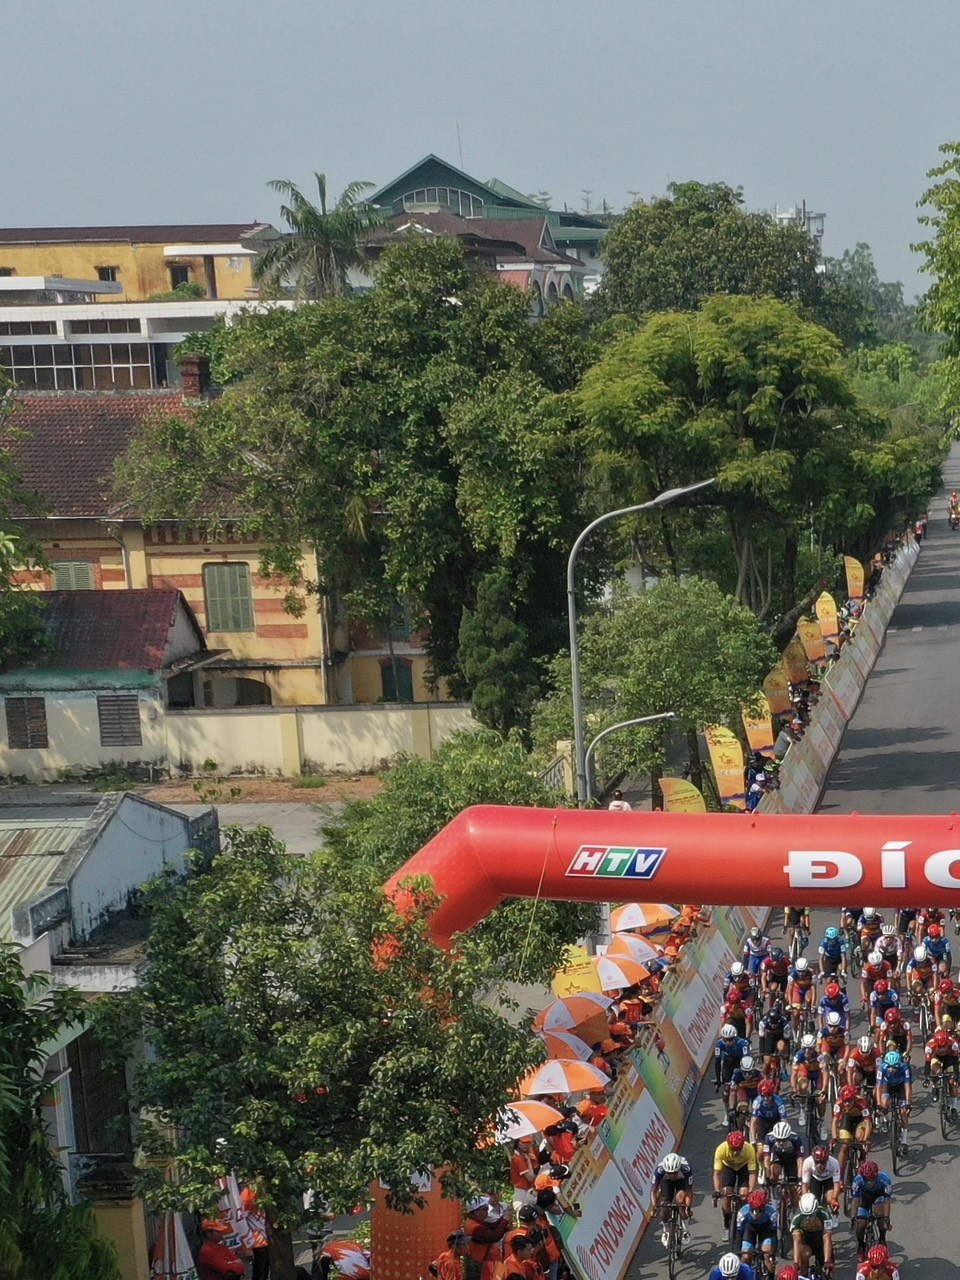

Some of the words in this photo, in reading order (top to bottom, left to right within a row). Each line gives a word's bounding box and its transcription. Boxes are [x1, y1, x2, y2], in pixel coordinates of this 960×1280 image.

[570, 848, 661, 876] HTV
[589, 1227, 616, 1273] TON
[603, 1195, 631, 1244] DONG
[620, 1186, 636, 1217] A
